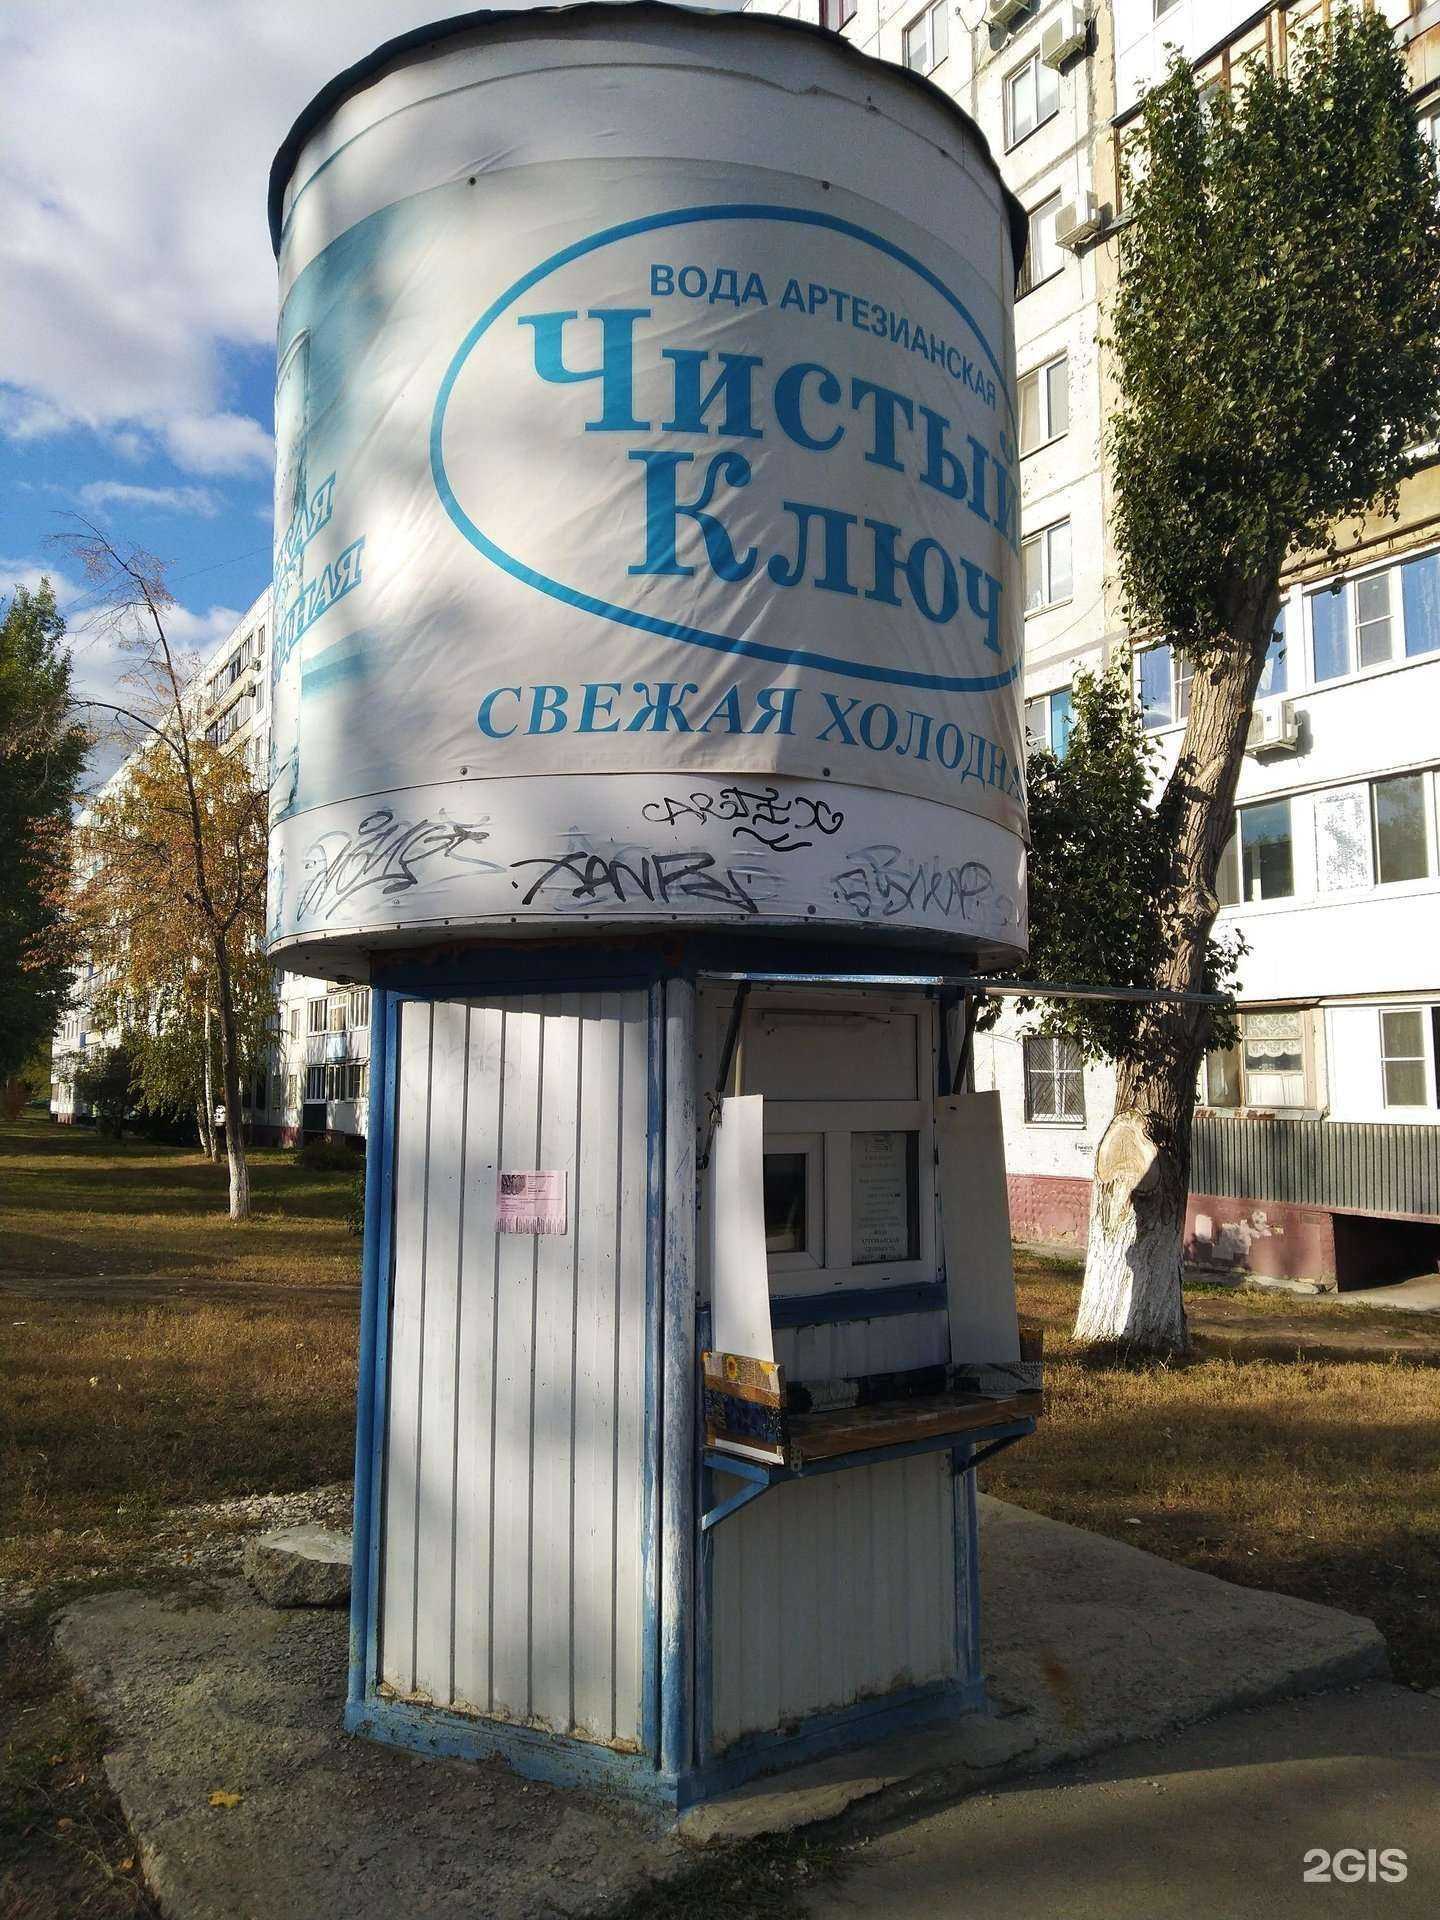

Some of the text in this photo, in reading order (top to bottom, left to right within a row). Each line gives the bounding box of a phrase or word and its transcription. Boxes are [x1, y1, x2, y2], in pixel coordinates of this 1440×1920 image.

[650, 264, 996, 411] ВОДА АРТЕЗИАНСКАЯ
[476, 681, 802, 740] СВЕЖАЯ
